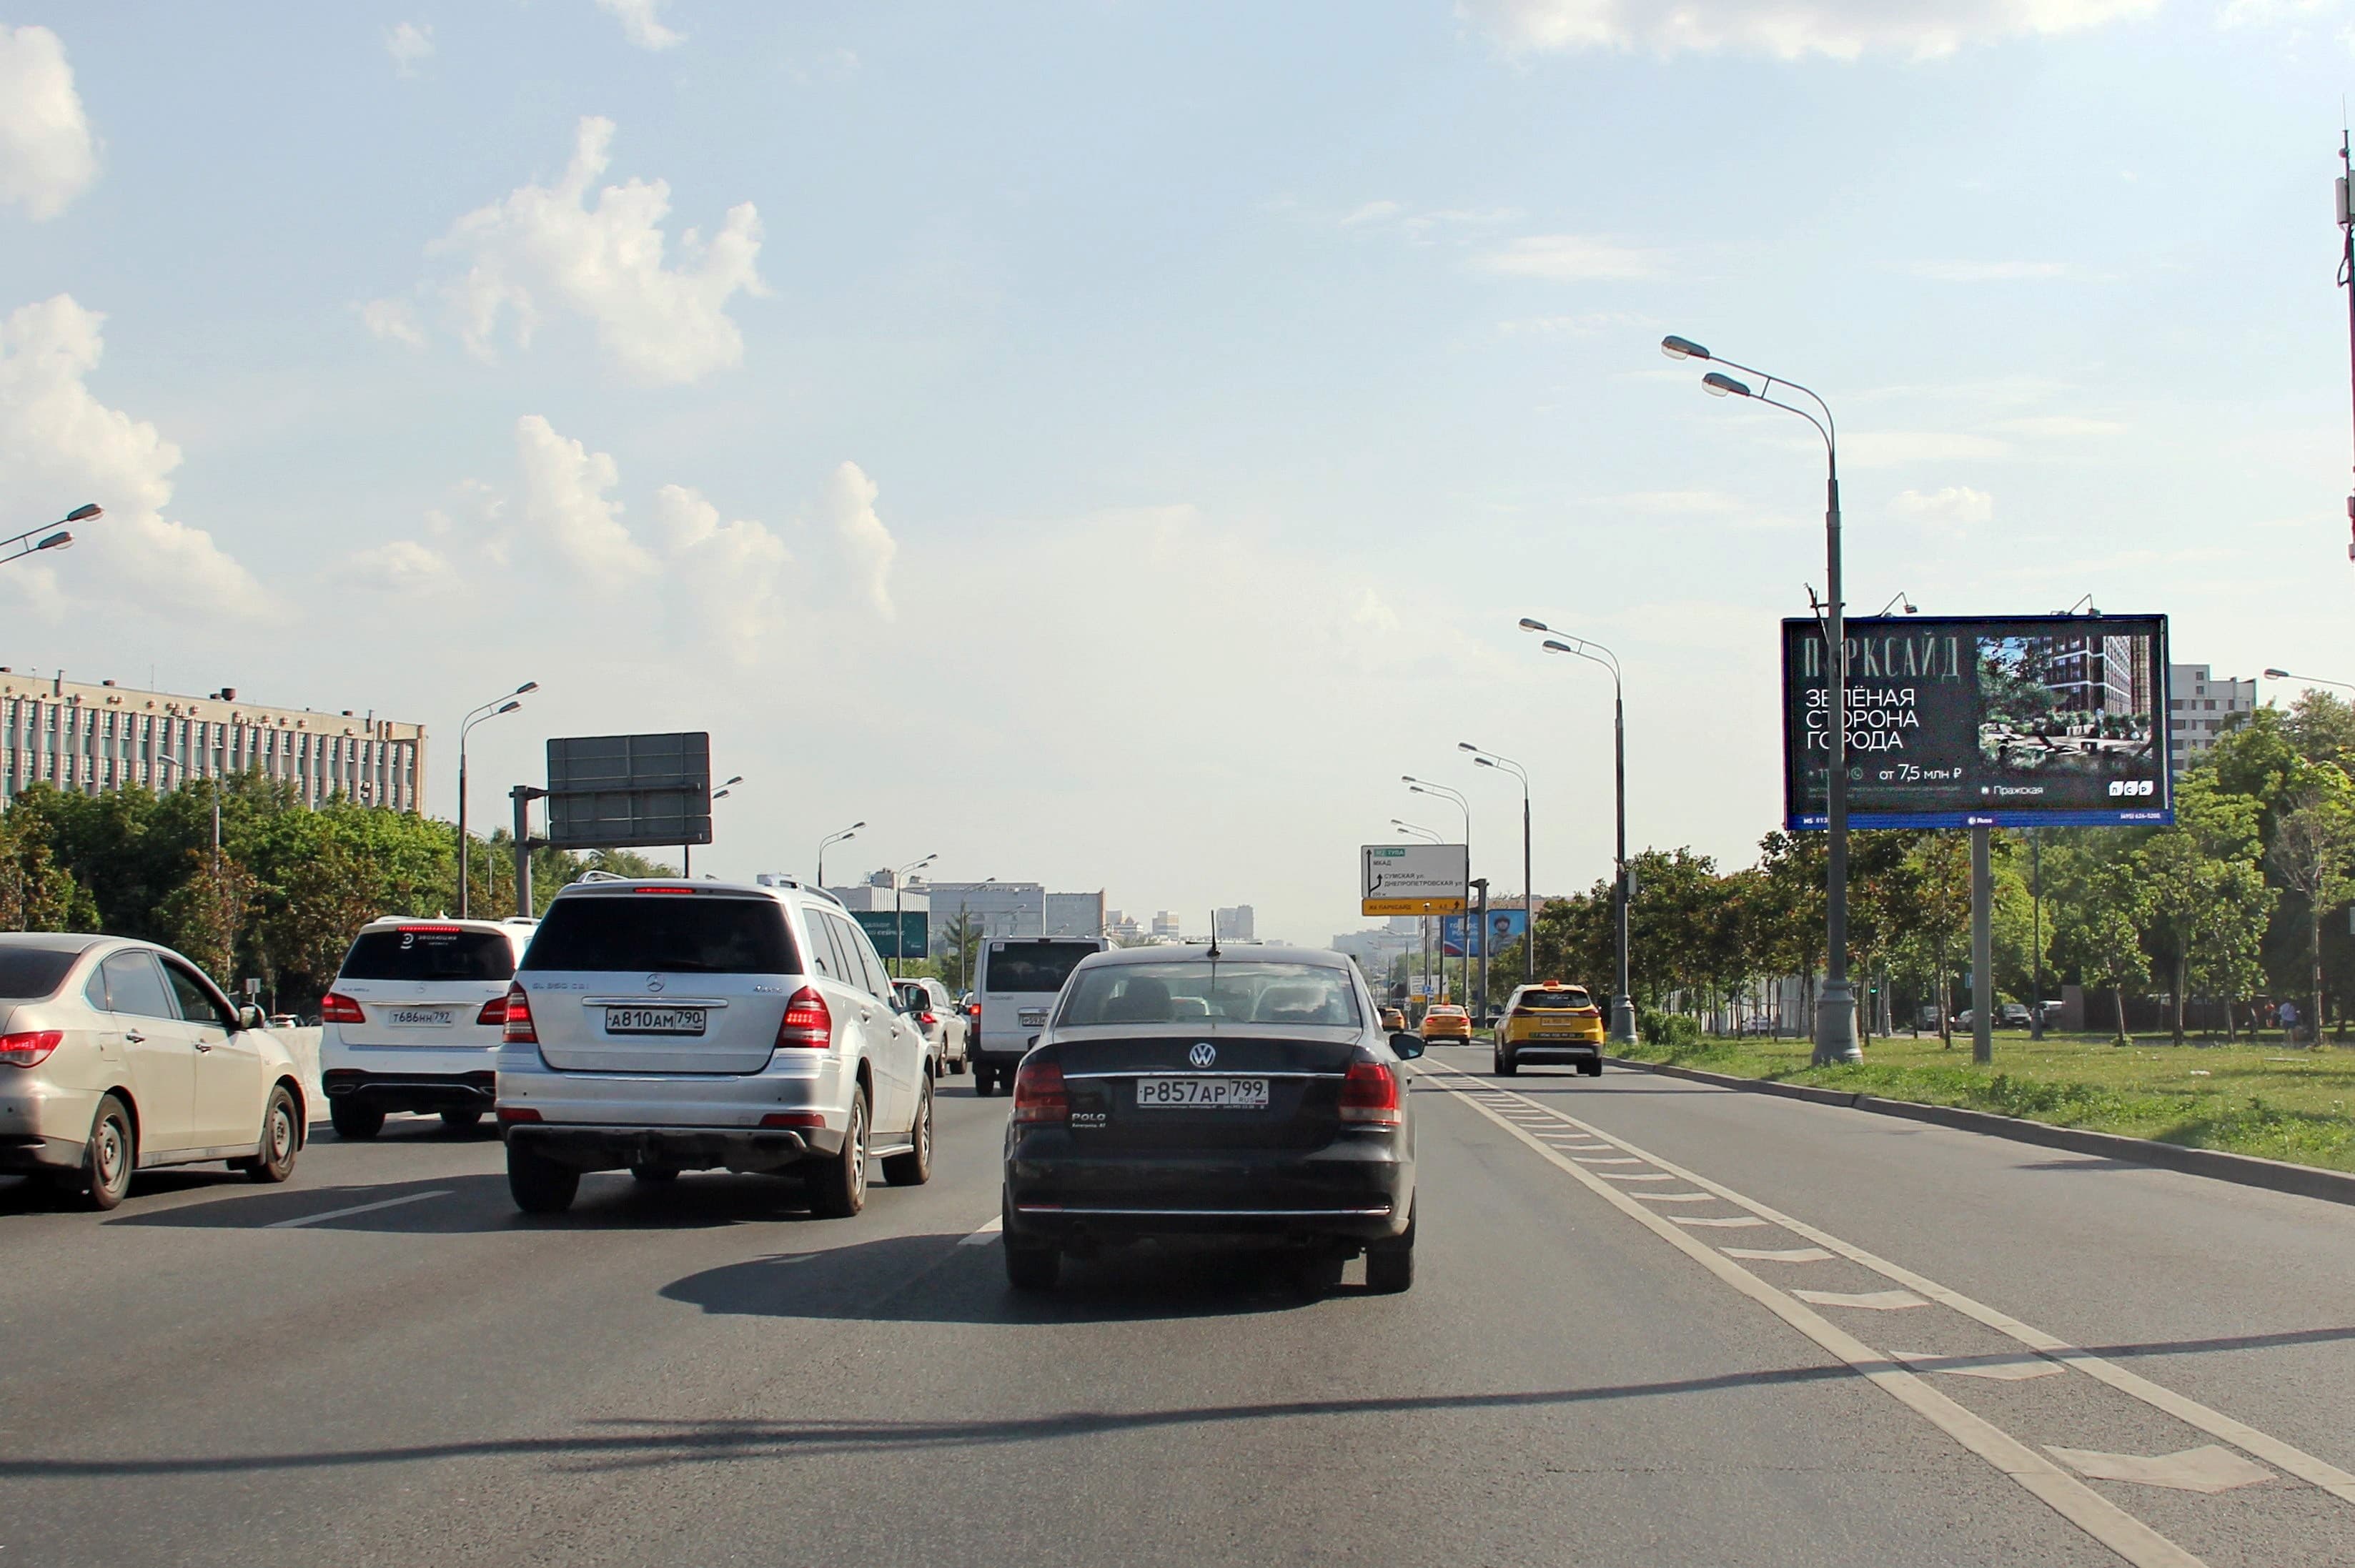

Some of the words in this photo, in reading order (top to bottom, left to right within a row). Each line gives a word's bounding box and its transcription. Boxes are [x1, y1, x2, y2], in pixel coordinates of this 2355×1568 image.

[1805, 631, 1960, 683] ПРКСАЙД
[1879, 770, 1895, 780] от
[1898, 764, 1920, 783] 7,5
[1923, 770, 1950, 780] млн
[393, 1011, 432, 1023] Т686НН
[611, 1011, 673, 1027] А810АМ
[677, 1011, 700, 1023] 790
[1144, 1081, 1226, 1102] Р857АР
[1231, 1080, 1263, 1097] 799
[1072, 1113, 1106, 1121] POLO
